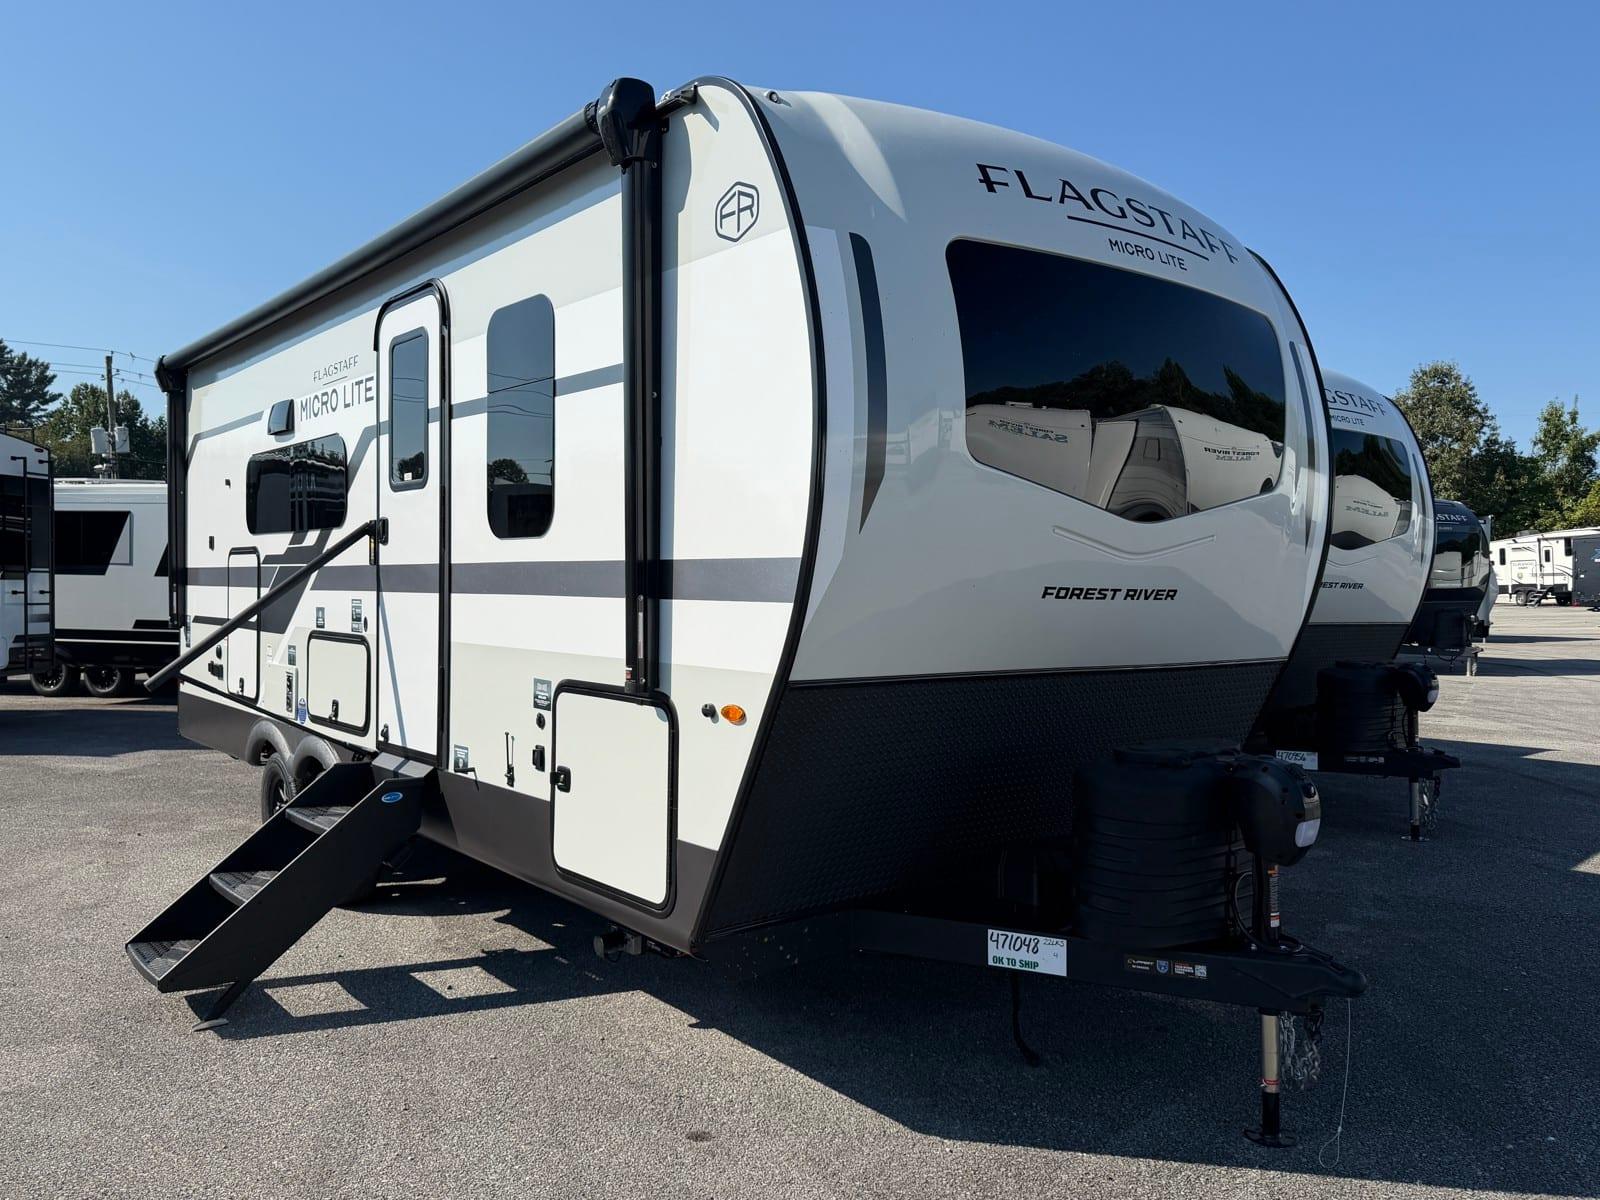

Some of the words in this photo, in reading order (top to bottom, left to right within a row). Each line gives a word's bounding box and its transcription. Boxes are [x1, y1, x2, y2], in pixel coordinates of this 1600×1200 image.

[976, 163, 1239, 264] FLAGSTAFF
[1108, 238, 1155, 261] MICRO
[1159, 251, 1188, 272] LITE
[313, 354, 359, 383] FLAGSTAFF
[300, 388, 339, 422] MICRO
[343, 375, 375, 409] LITE
[1351, 418, 1366, 426] LITE
[1041, 585, 1122, 601] FOREST
[1123, 588, 1179, 601] RIVER
[1340, 582, 1364, 590] RIVER
[989, 931, 1040, 955] 471048
[992, 955, 1005, 965] OK
[1006, 957, 1017, 967] TO
[1018, 959, 1040, 970] SHIP
